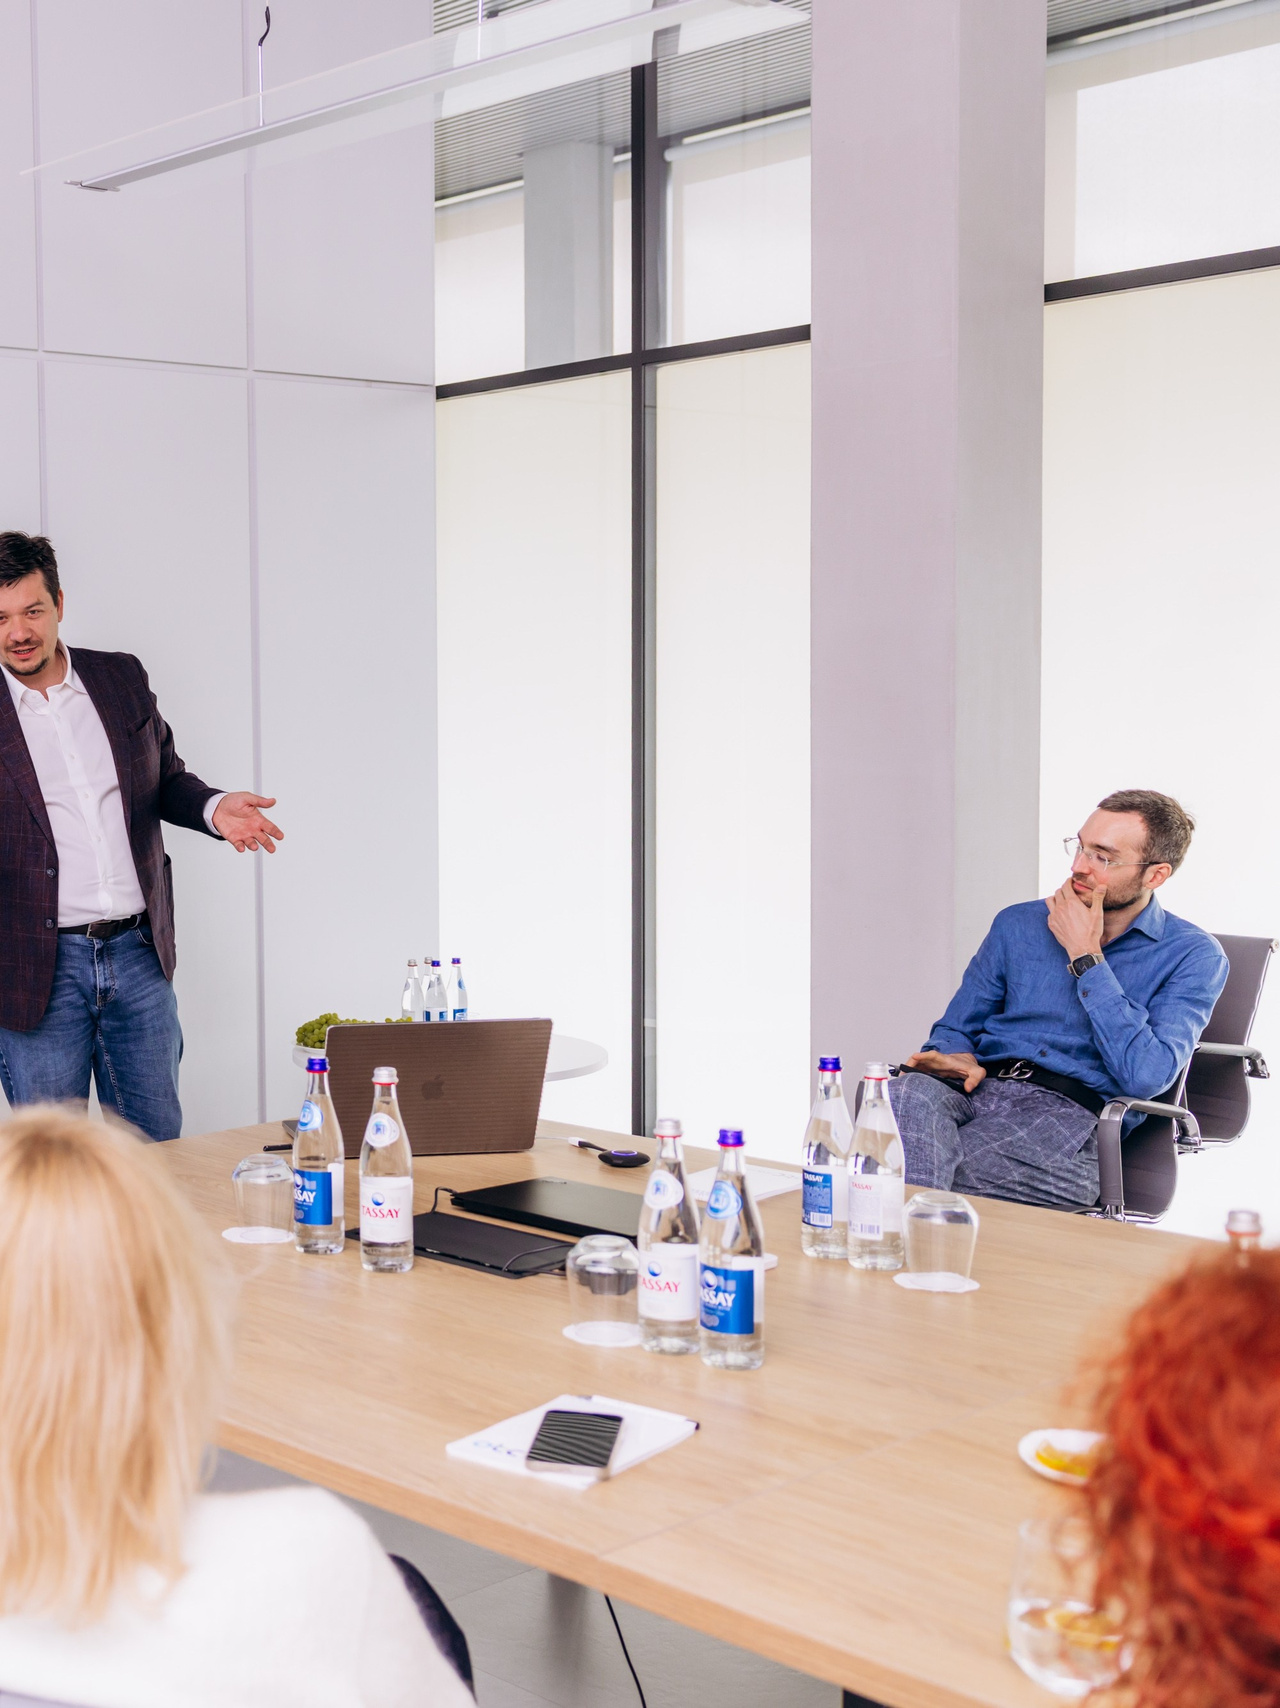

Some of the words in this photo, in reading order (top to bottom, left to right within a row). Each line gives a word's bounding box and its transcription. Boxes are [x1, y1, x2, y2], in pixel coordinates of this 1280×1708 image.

[804, 1172, 824, 1183] TASSAY
[851, 1181, 873, 1191] TASSAY
[294, 1189, 317, 1203] SSAY
[362, 1205, 401, 1219] TASSAY
